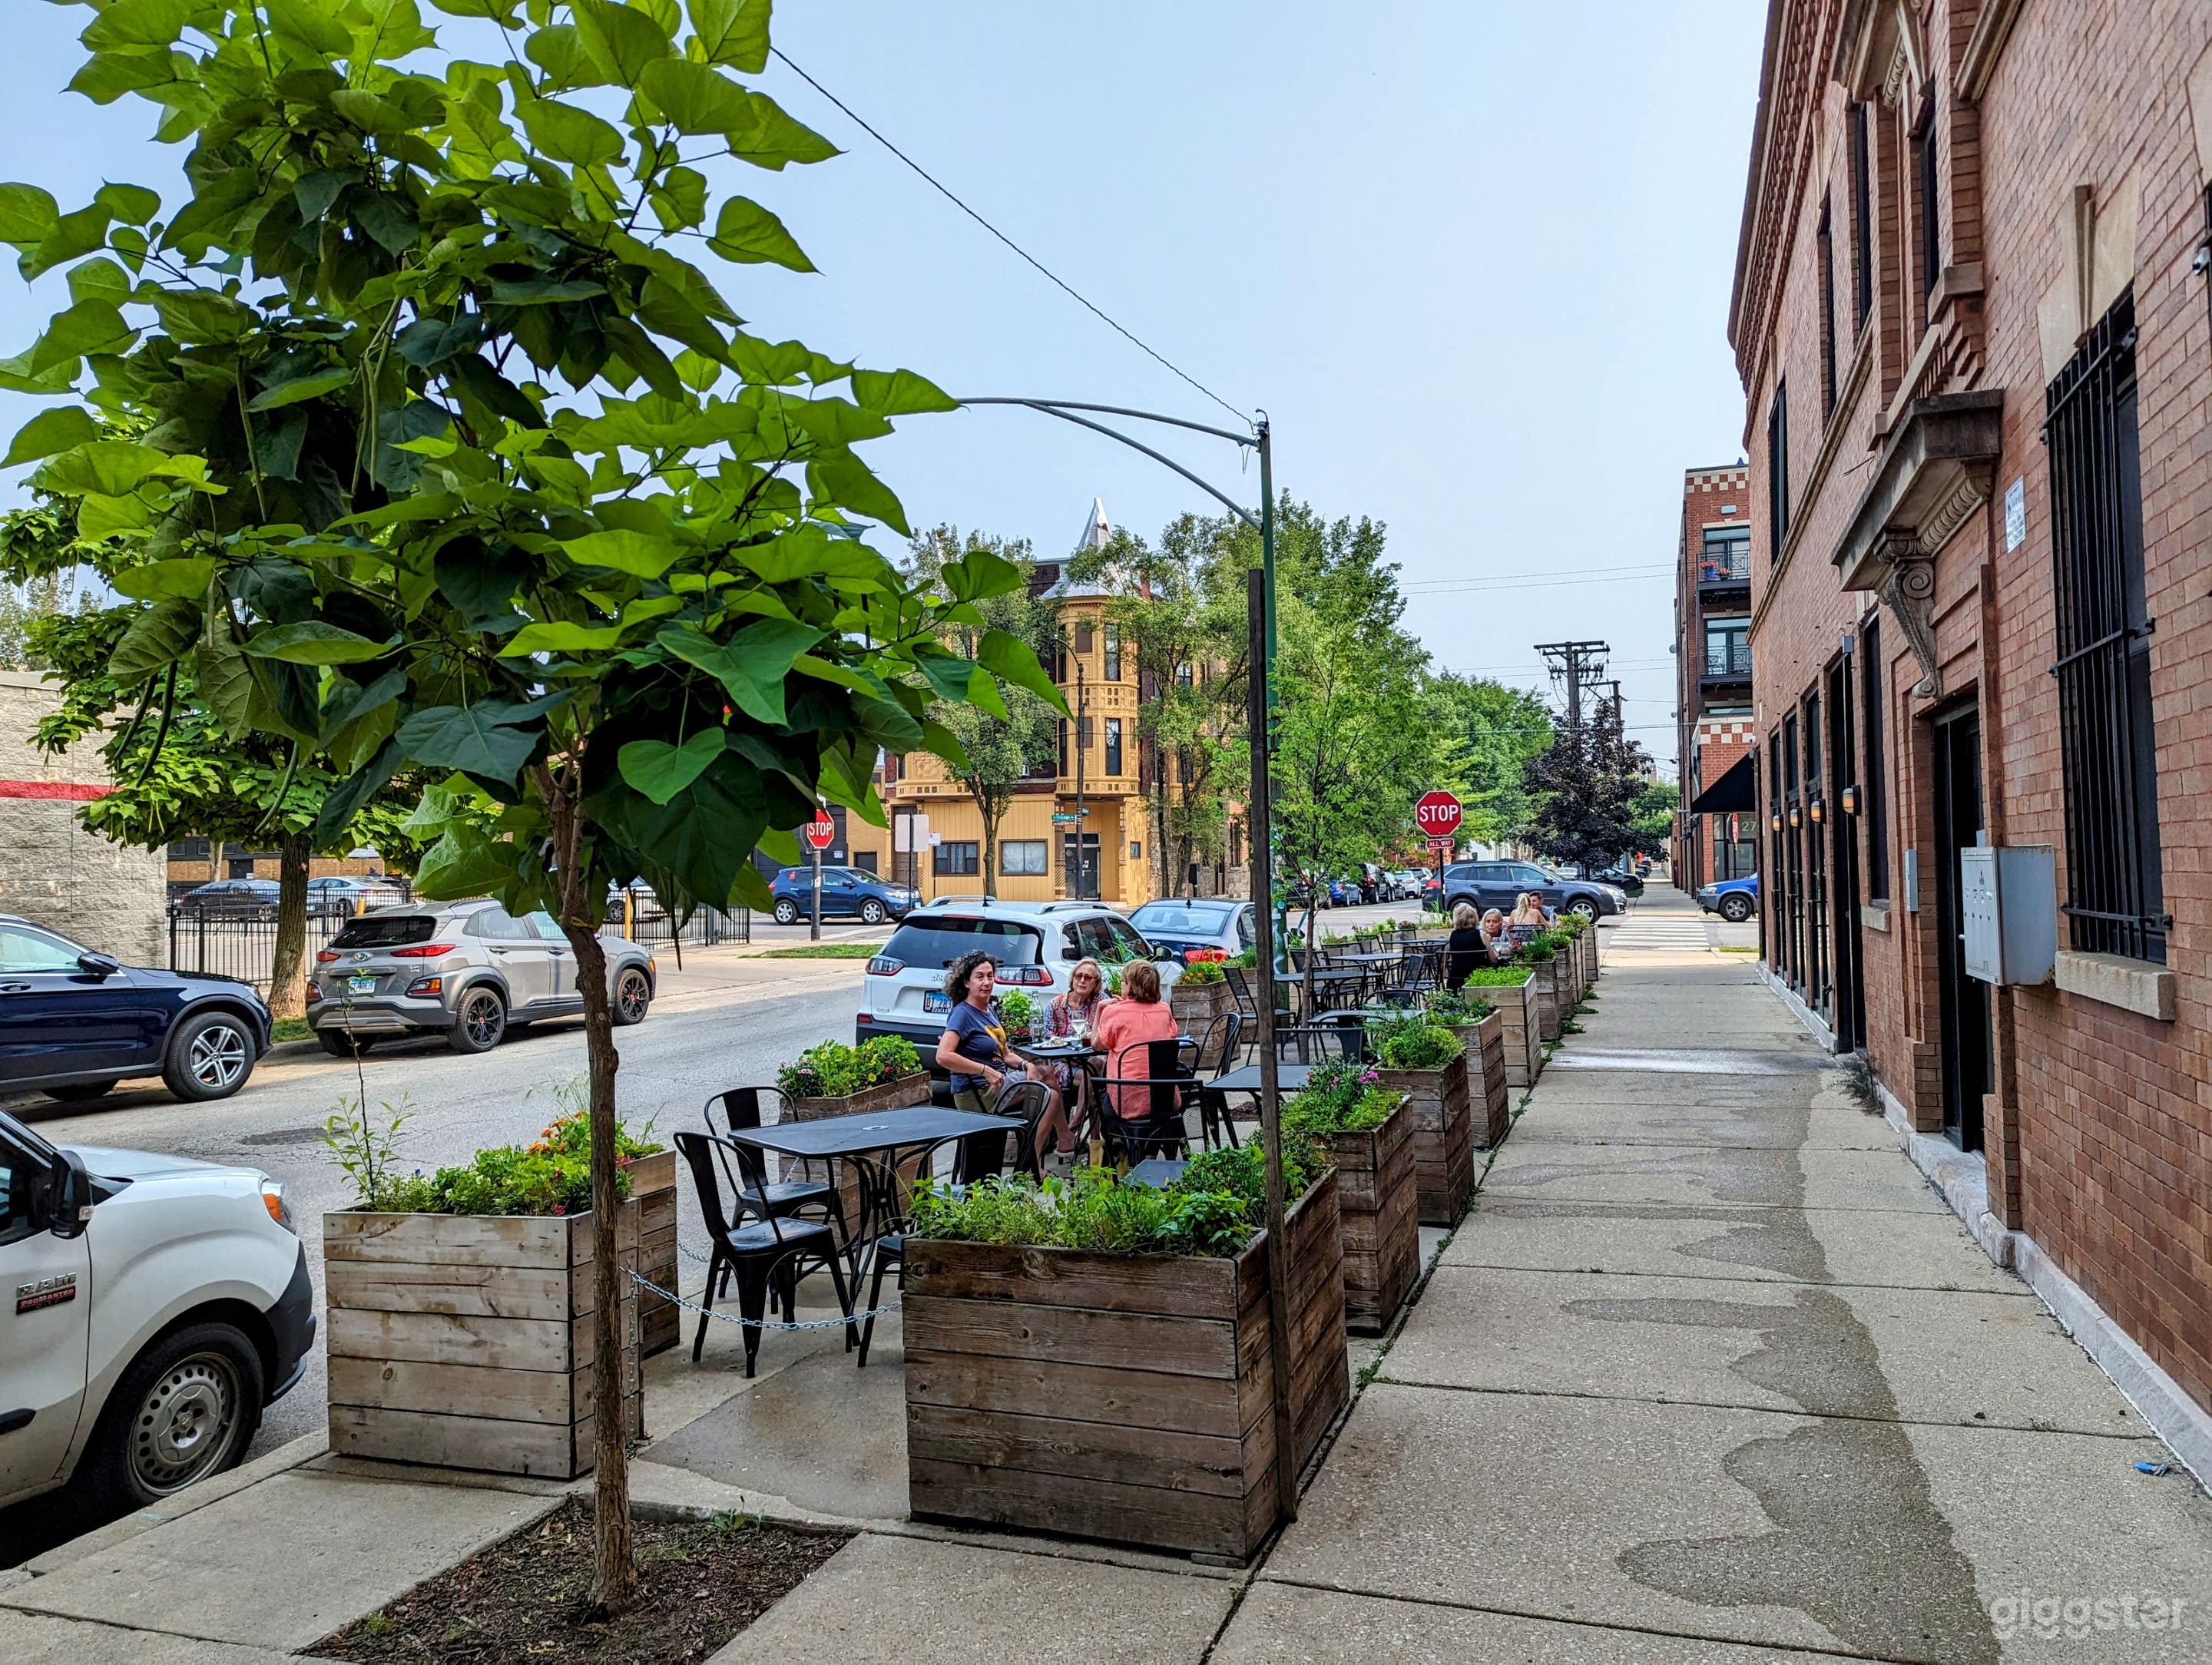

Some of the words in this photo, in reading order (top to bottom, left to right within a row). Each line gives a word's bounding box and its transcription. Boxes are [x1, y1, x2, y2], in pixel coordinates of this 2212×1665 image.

[1419, 804, 1459, 823] STOP
[809, 822, 833, 836] STOP
[16, 1271, 77, 1298] RAM
